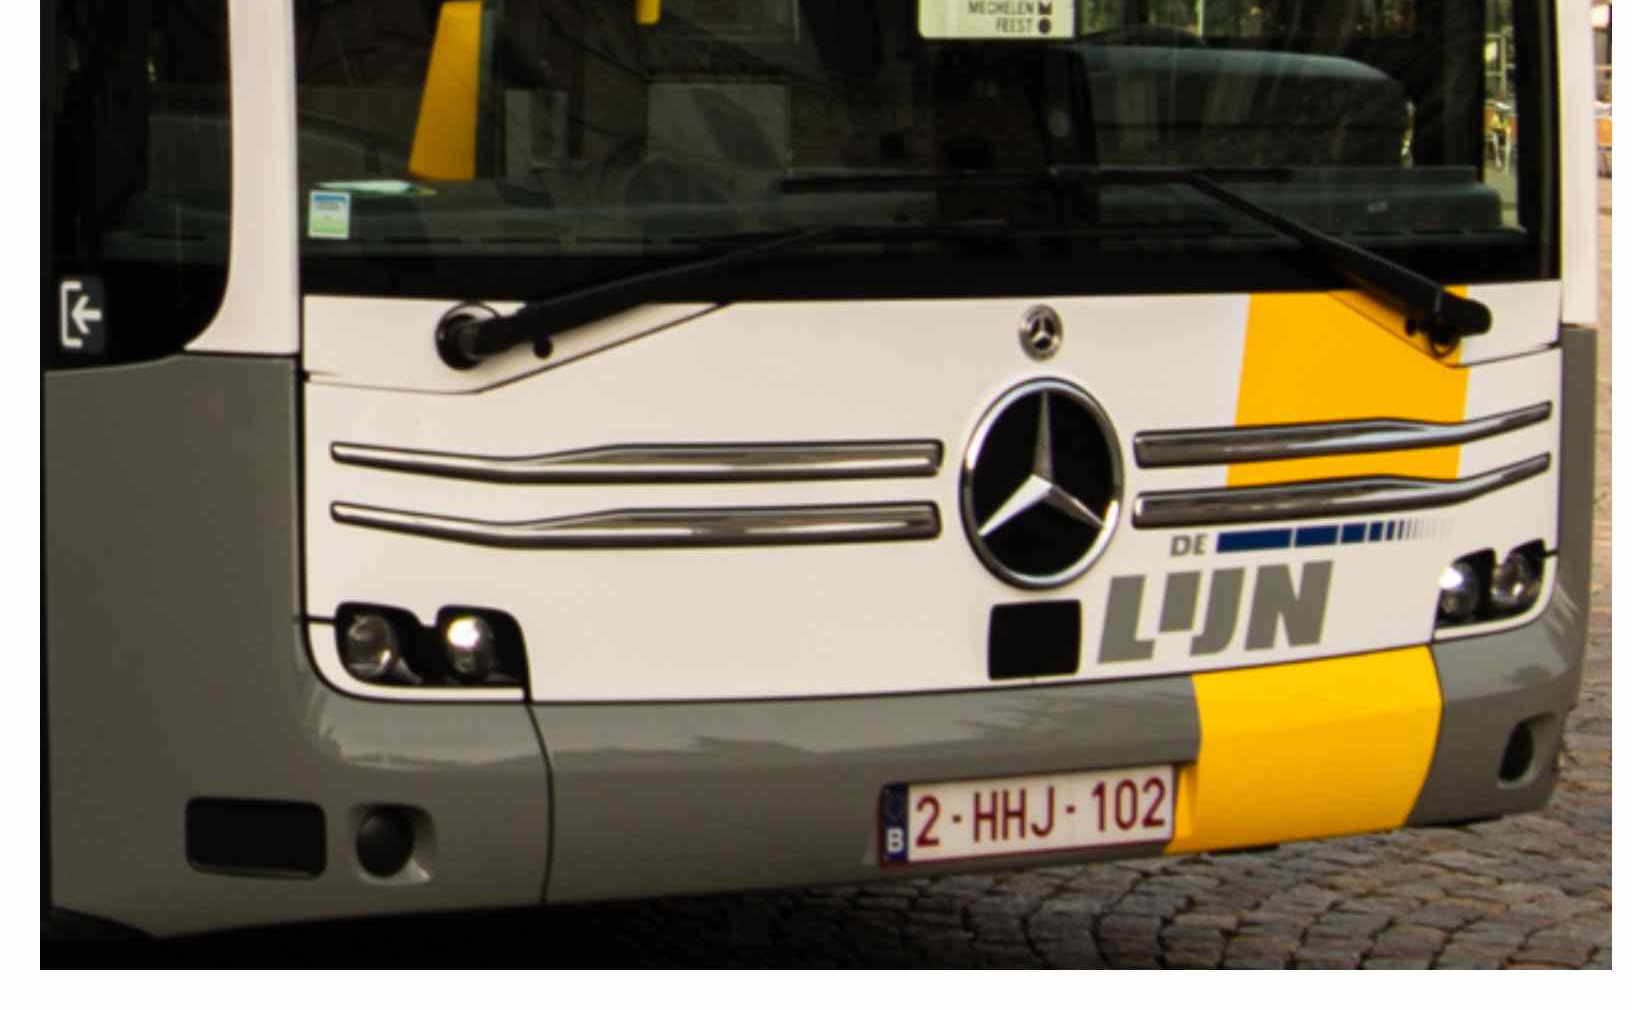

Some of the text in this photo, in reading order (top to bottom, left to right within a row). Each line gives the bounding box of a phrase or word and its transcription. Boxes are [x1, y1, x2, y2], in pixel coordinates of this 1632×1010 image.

[967, 0, 1034, 15] MECHELEN
[995, 16, 1034, 33] FEEST
[1170, 533, 1207, 557] DE
[1097, 560, 1334, 664] LIJN
[886, 827, 905, 854] B
